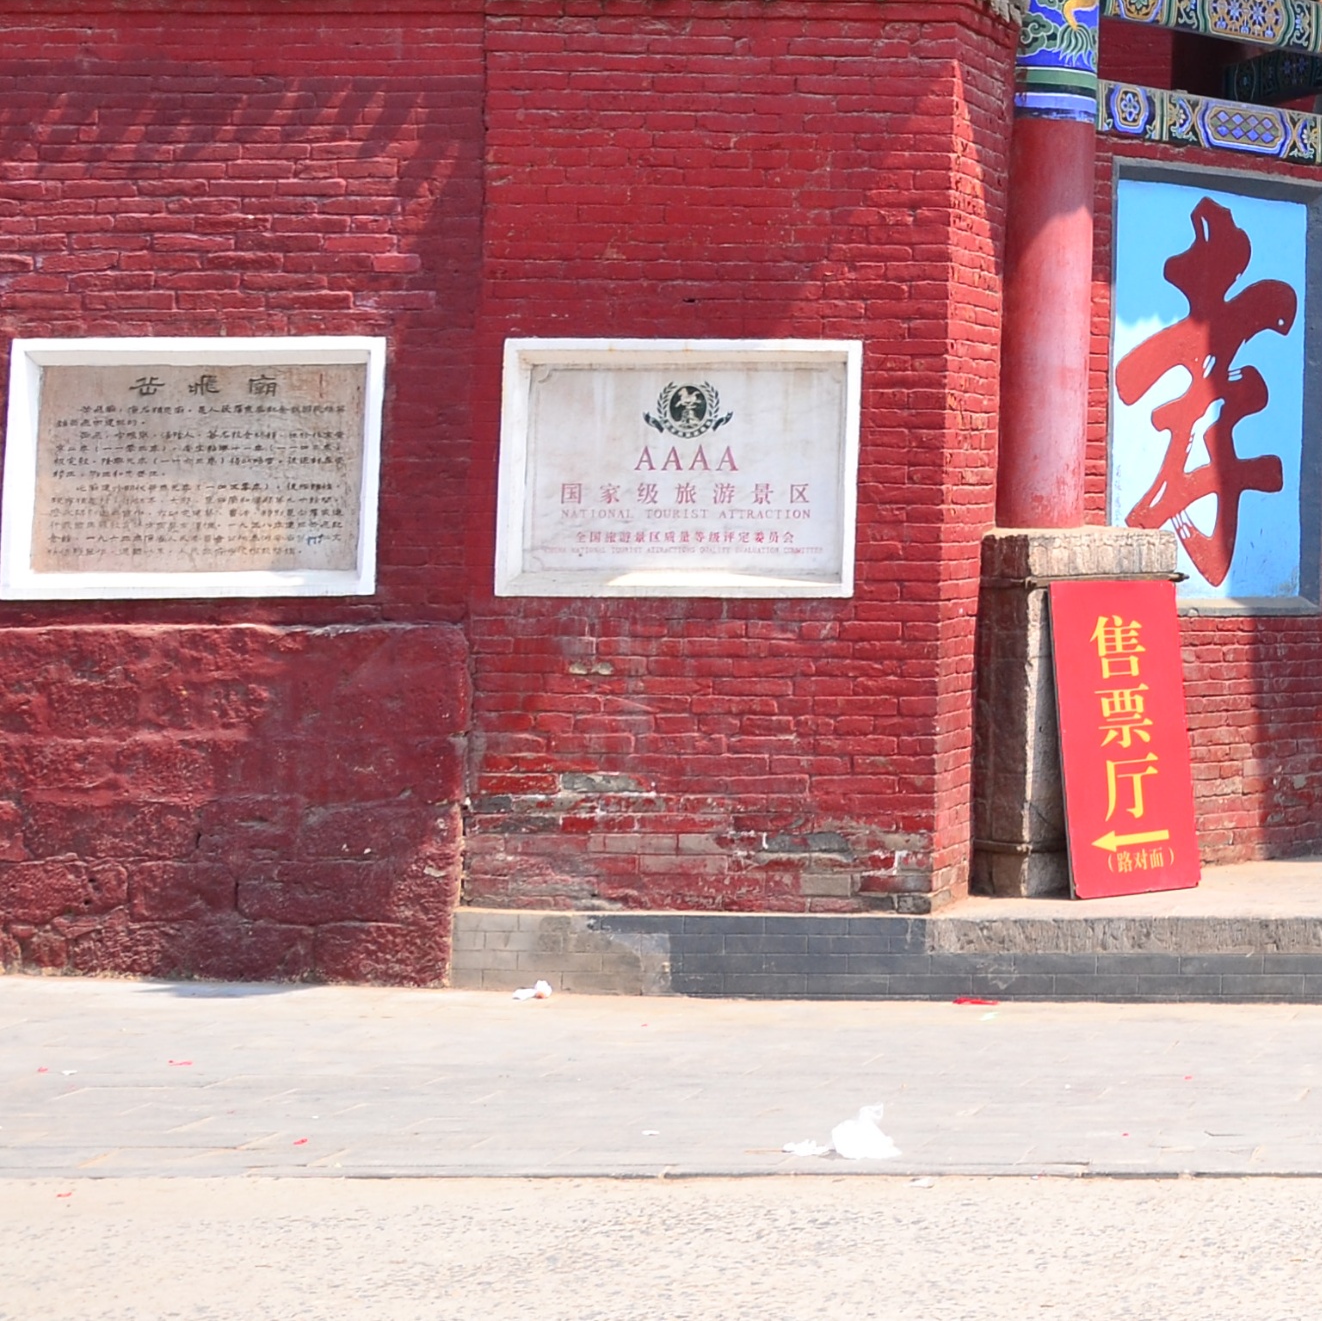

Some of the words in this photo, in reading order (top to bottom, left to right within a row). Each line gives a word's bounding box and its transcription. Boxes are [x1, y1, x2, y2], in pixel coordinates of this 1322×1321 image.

[634, 444, 739, 471] AAAA
[560, 482, 810, 505] 国家级旅游景区
[561, 508, 634, 519] NATIONAL
[645, 508, 708, 519] TOURIST
[718, 508, 811, 519] ATTRACTION
[576, 530, 794, 544] 全国旅游景区质量等级评定委员会
[1090, 615, 1159, 821] 售票厅
[1108, 846, 1174, 873] （路对面）
